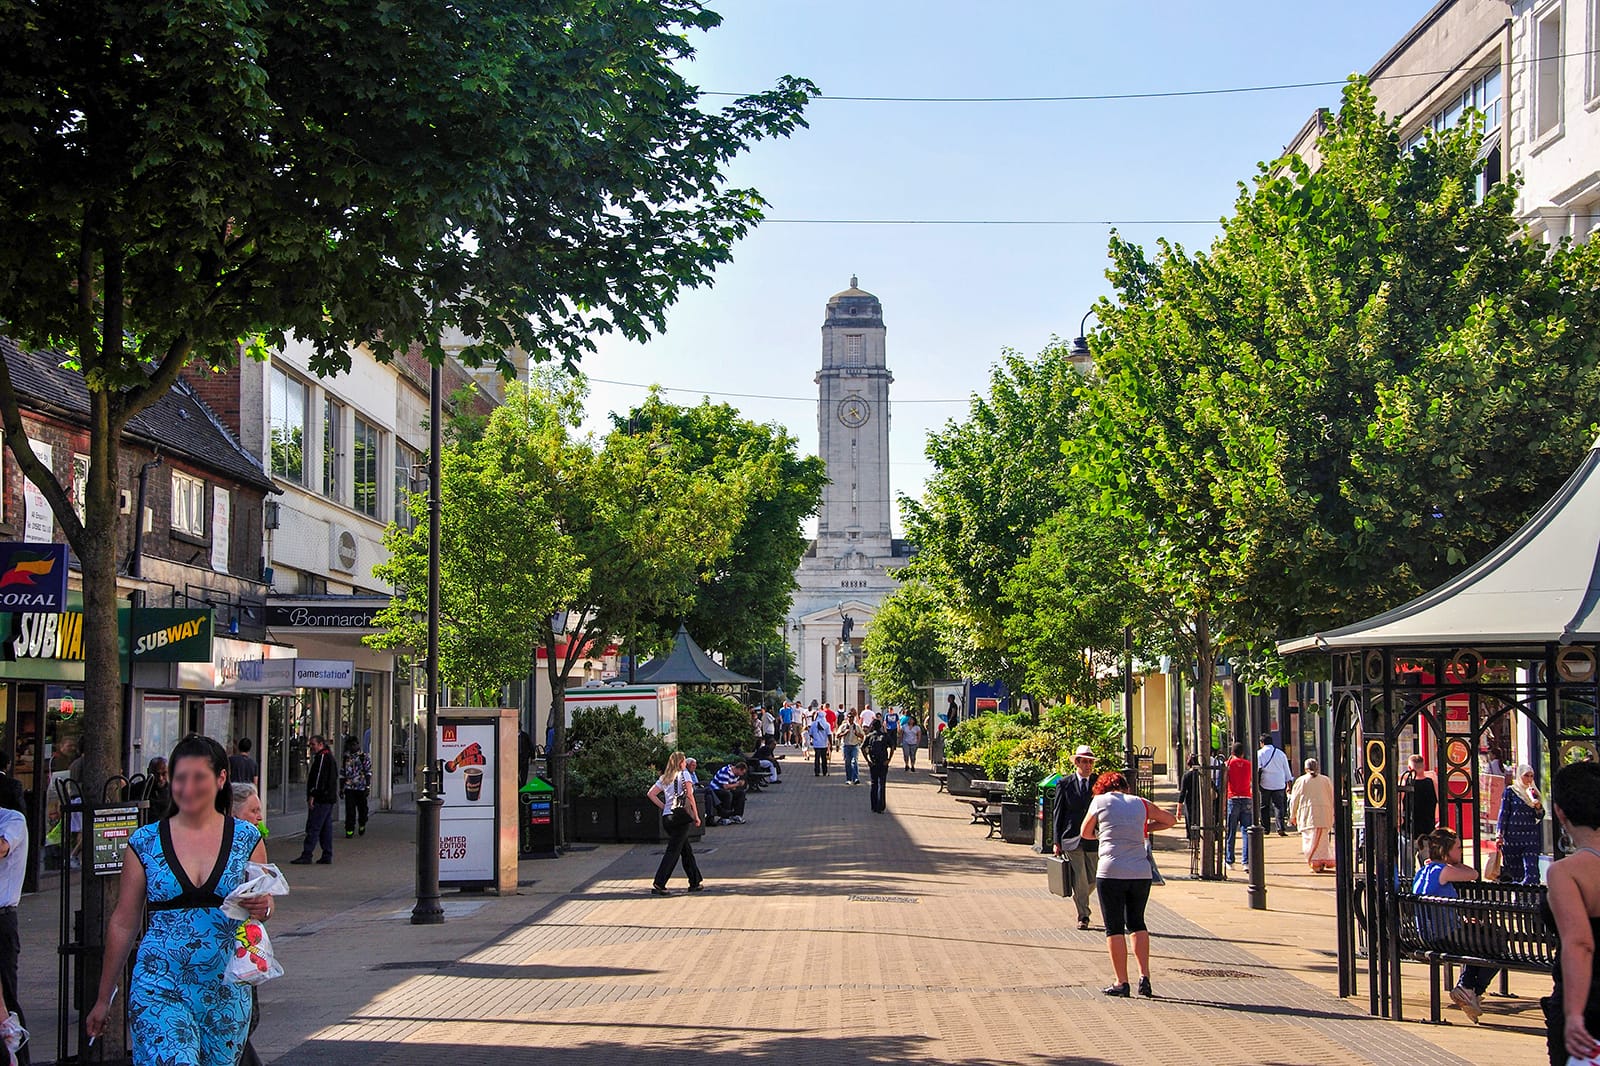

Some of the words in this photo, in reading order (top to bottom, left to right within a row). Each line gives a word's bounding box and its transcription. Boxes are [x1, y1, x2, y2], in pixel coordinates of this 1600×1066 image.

[0, 593, 56, 606] ORAL
[290, 607, 374, 627] Bonmarch
[13, 612, 86, 660] SUBWA
[134, 615, 207, 655] SUBWAY
[297, 668, 350, 680] gamestation
[439, 848, 467, 859] £1.69
